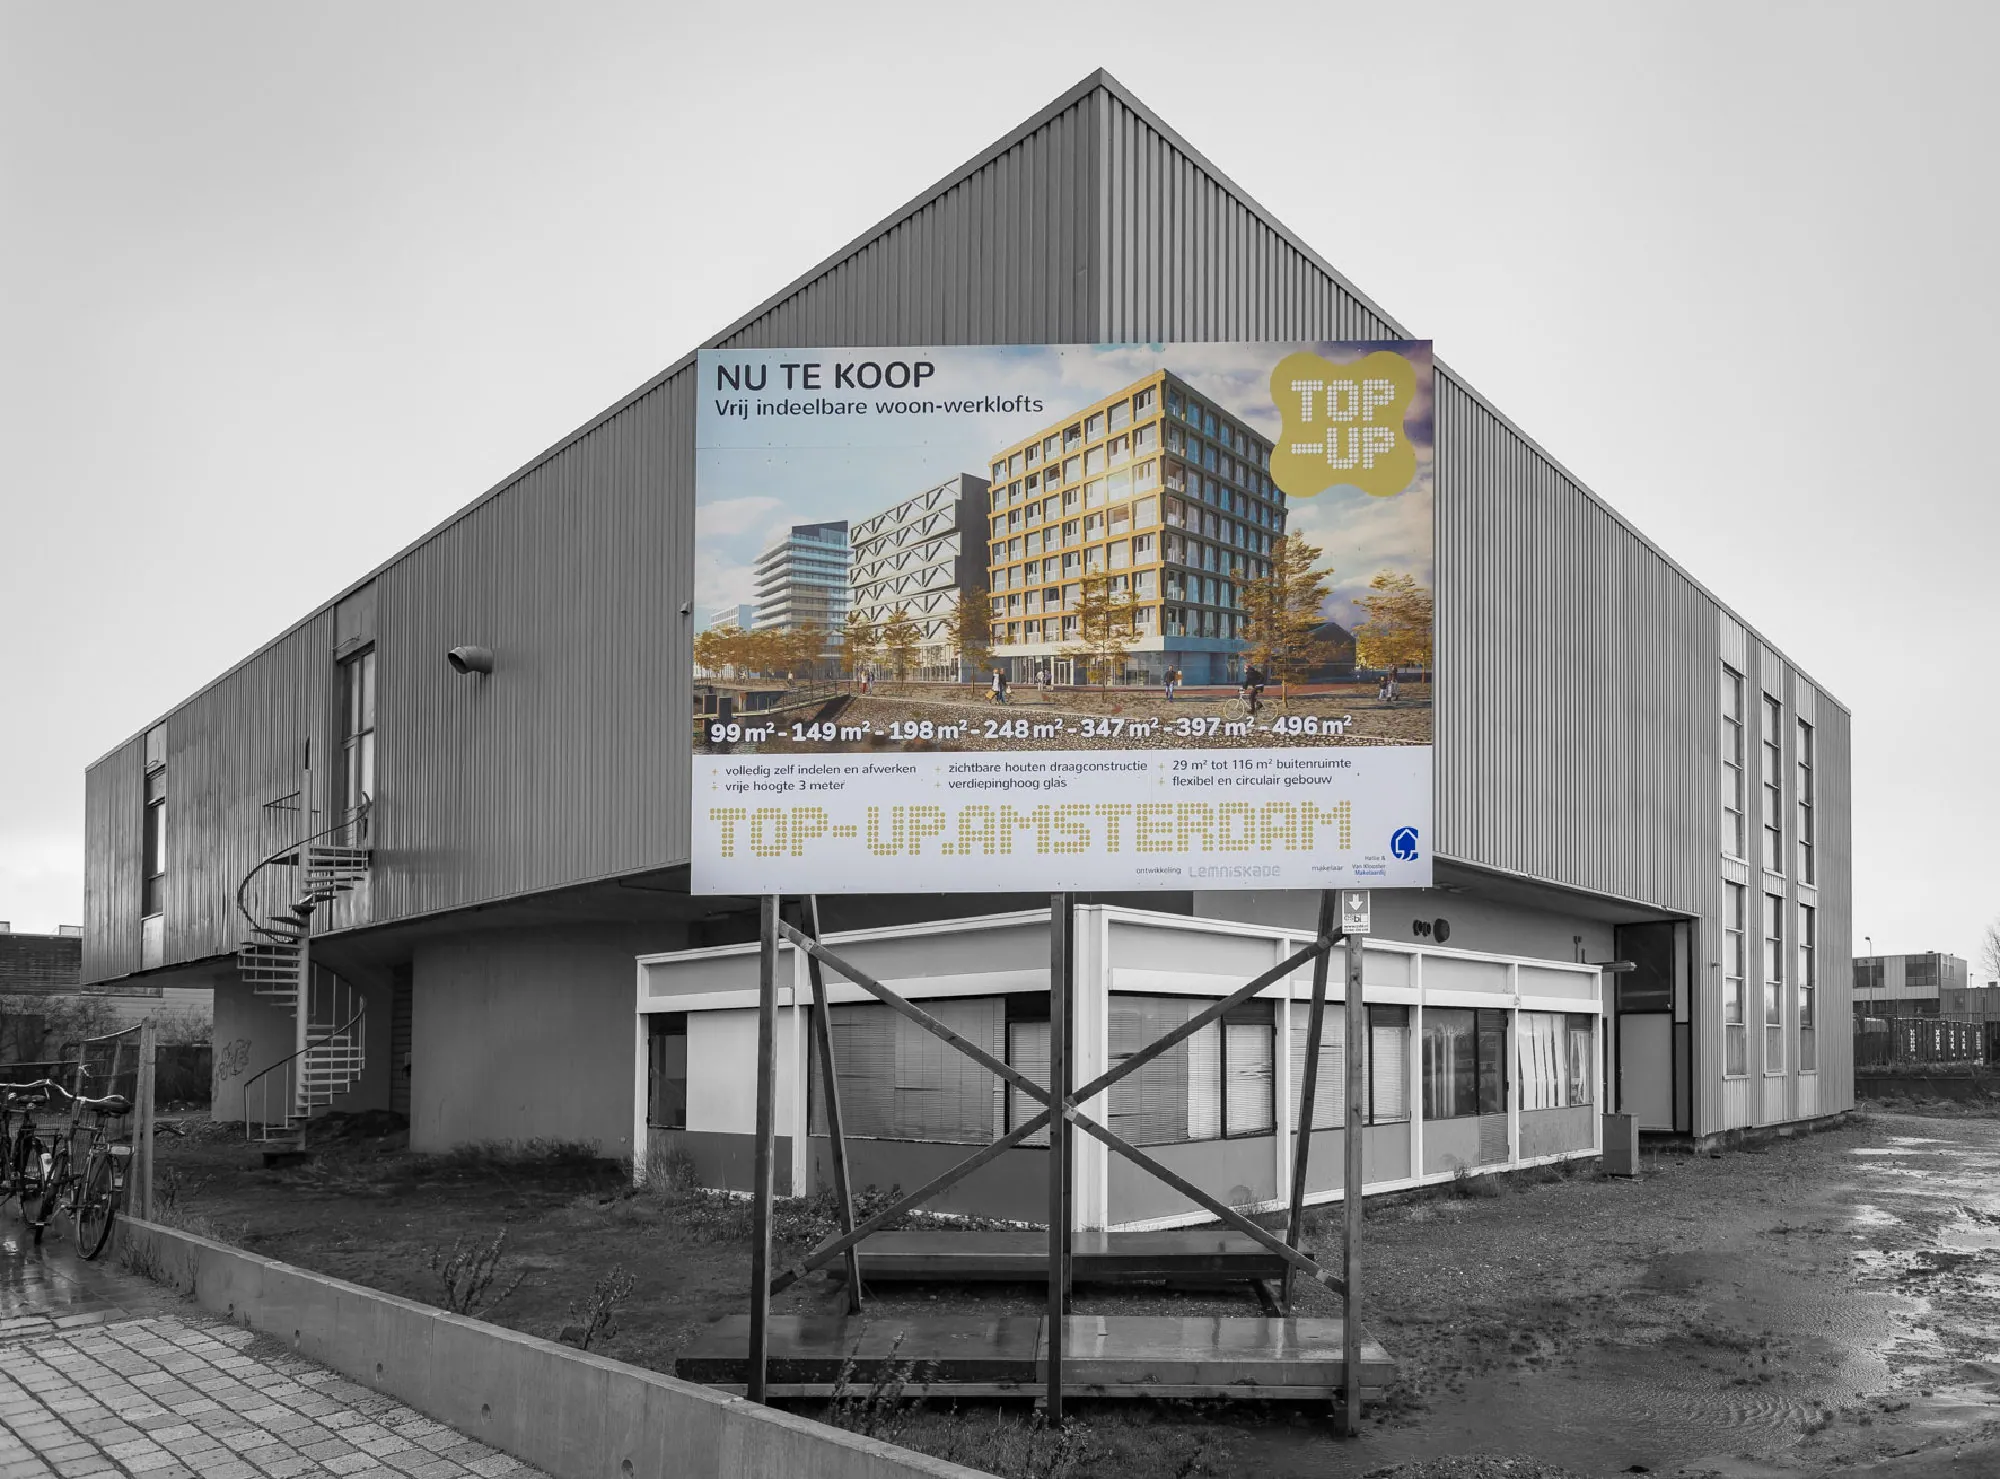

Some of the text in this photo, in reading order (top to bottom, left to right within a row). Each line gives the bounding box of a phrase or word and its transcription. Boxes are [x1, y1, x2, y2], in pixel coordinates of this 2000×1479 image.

[717, 361, 935, 391] NU TE KOOP
[716, 395, 1044, 420] Vrij indeelbare woon-werklofts
[1291, 379, 1395, 422] TOP
[711, 723, 740, 743] 99
[792, 722, 837, 742] 149
[889, 720, 932, 740] 198
[984, 719, 1029, 738] 248
[1080, 718, 1125, 738] 347
[1176, 717, 1221, 736] 397
[1272, 715, 1318, 735] 496
[725, 763, 916, 778] volledig zelf indelen en afwerken
[949, 760, 1148, 773] zichtbare houten draagconstructie
[1172, 760, 1188, 770] 29
[1211, 760, 1228, 770] tot
[1232, 759, 1253, 770] 116
[1276, 758, 1351, 769] buitenruimte
[725, 779, 845, 794] vrije hoogte 3 meter
[948, 777, 1067, 790] verdiepinghoog glas
[1172, 774, 1332, 787] flexibel en circulair gebouw
[1136, 867, 1182, 875] ontwikkeling
